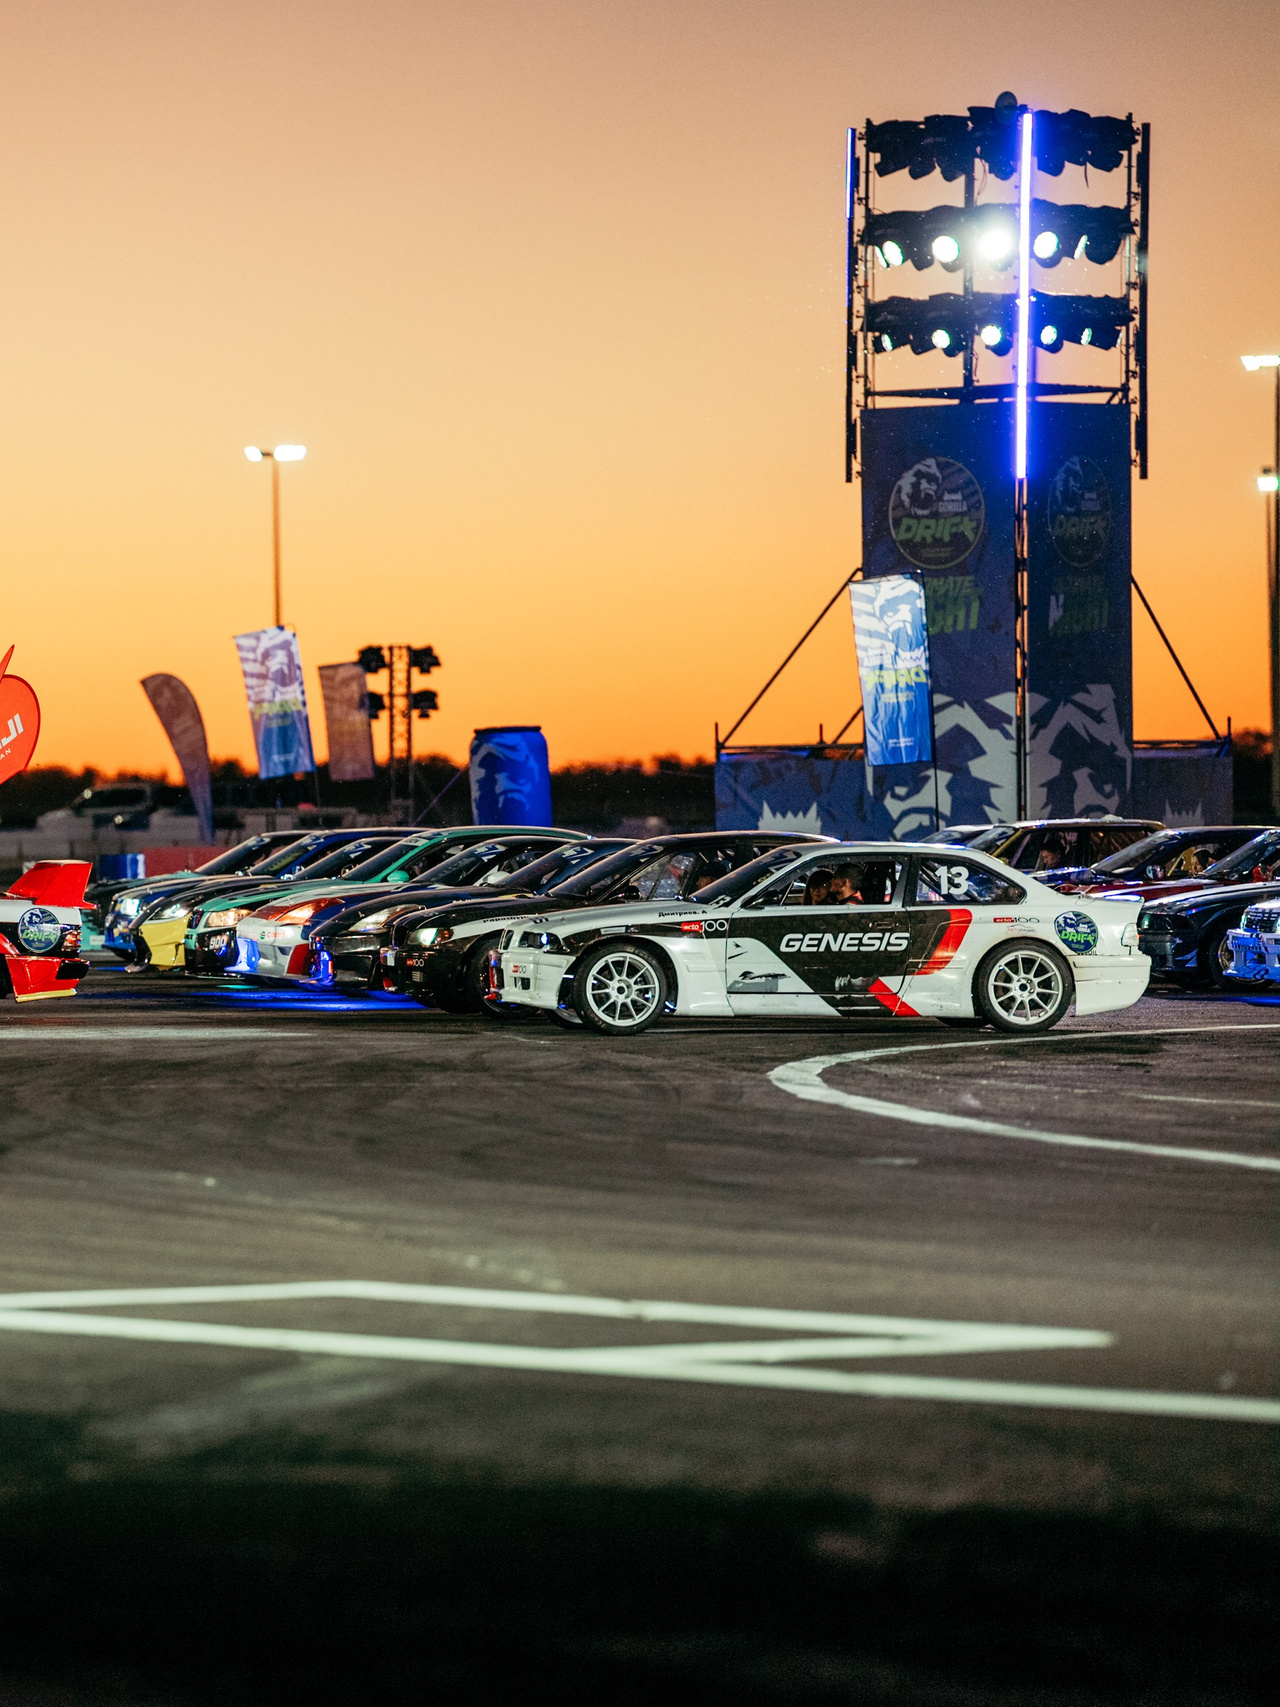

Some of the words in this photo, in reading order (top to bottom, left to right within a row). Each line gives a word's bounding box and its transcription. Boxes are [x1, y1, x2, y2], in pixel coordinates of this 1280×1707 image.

[897, 515, 977, 543] DRIFT
[935, 866, 969, 895] 13
[22, 929, 57, 942] DRIFT
[780, 932, 909, 952] GENESIS
[1060, 930, 1095, 945] DRIFT
